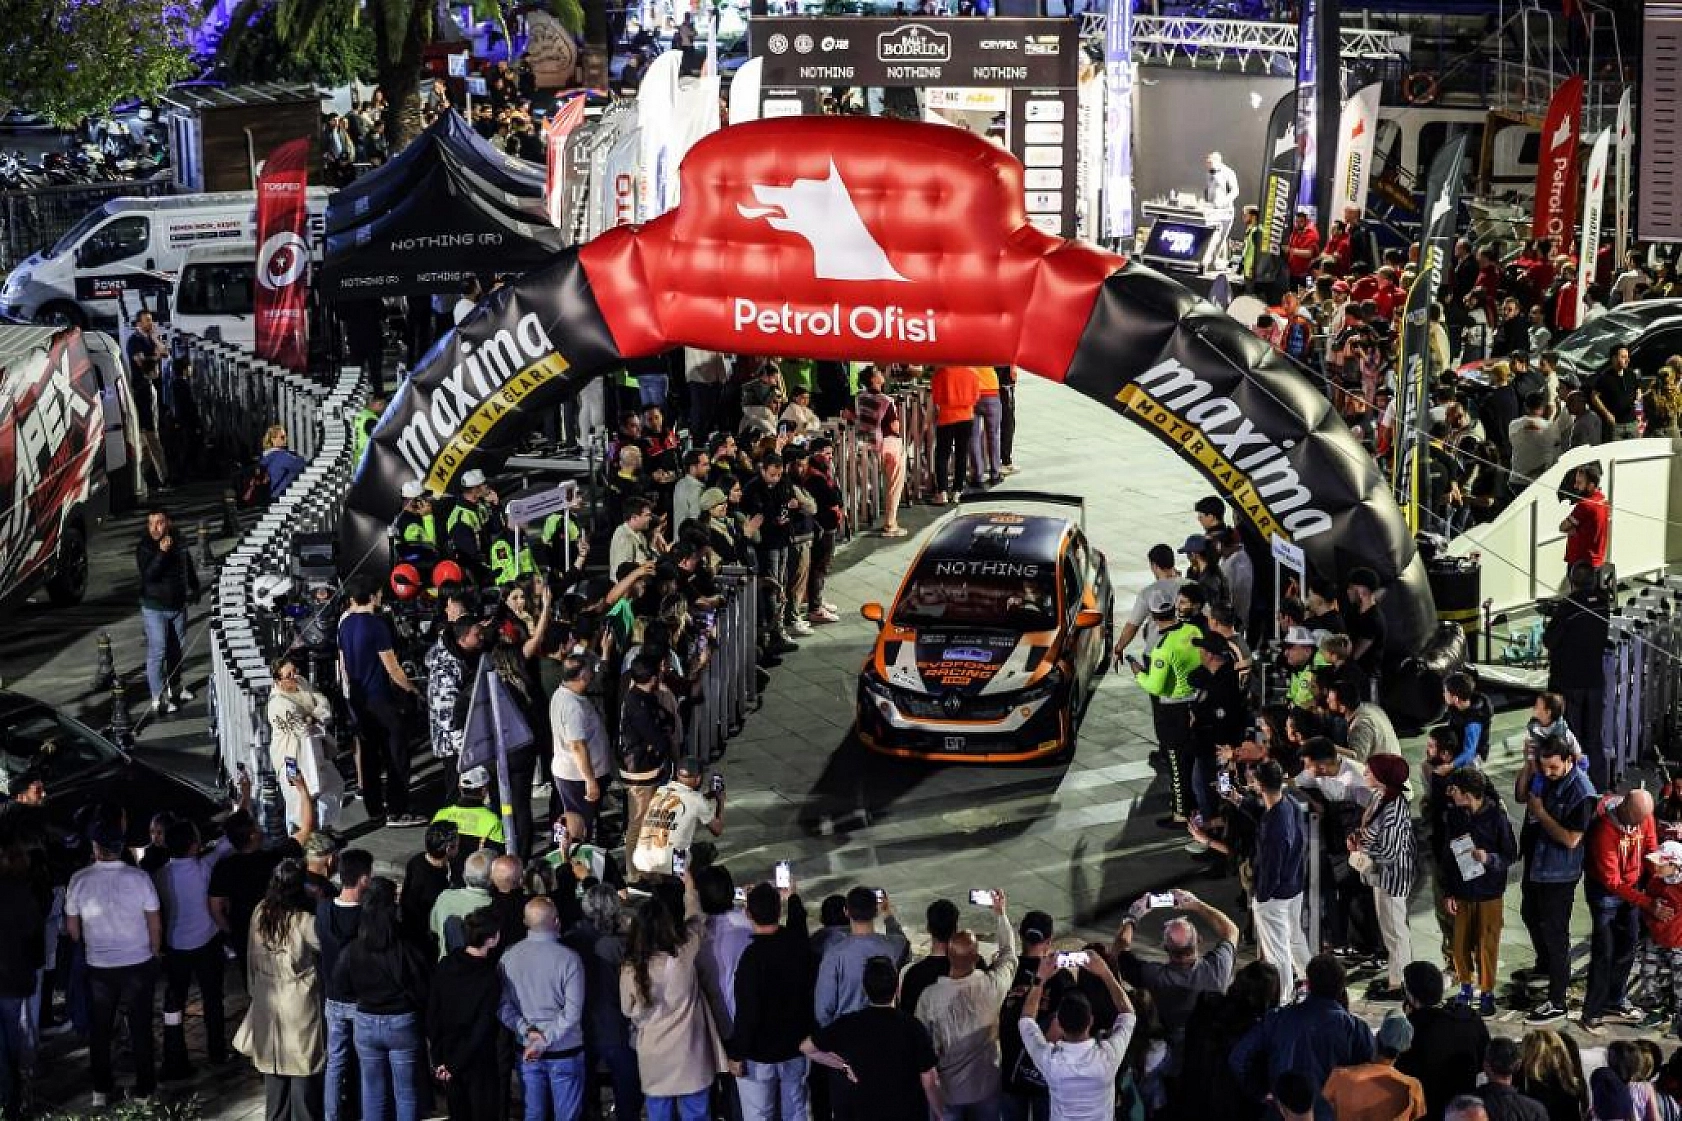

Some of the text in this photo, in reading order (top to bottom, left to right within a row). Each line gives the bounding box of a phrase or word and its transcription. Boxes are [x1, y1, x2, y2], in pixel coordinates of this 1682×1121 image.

[884, 43, 945, 55] BODRUM
[800, 66, 854, 79] NOTHING
[887, 66, 941, 79] NOTHING
[973, 66, 1028, 79] NOTHING
[1547, 157, 1567, 214] Petrol
[1270, 177, 1290, 256] maxima
[391, 232, 503, 250] NOTHING (R)
[341, 277, 385, 287] NOTHING
[417, 272, 461, 282] NOTHING
[734, 297, 937, 342] Petrol Ofisi
[397, 311, 555, 481] maxima
[435, 365, 553, 483] MOTOR YAĞLARI
[1135, 399, 1205, 455] MOTOR
[1133, 357, 1333, 541] maxima
[935, 561, 1039, 577] NOTHING
